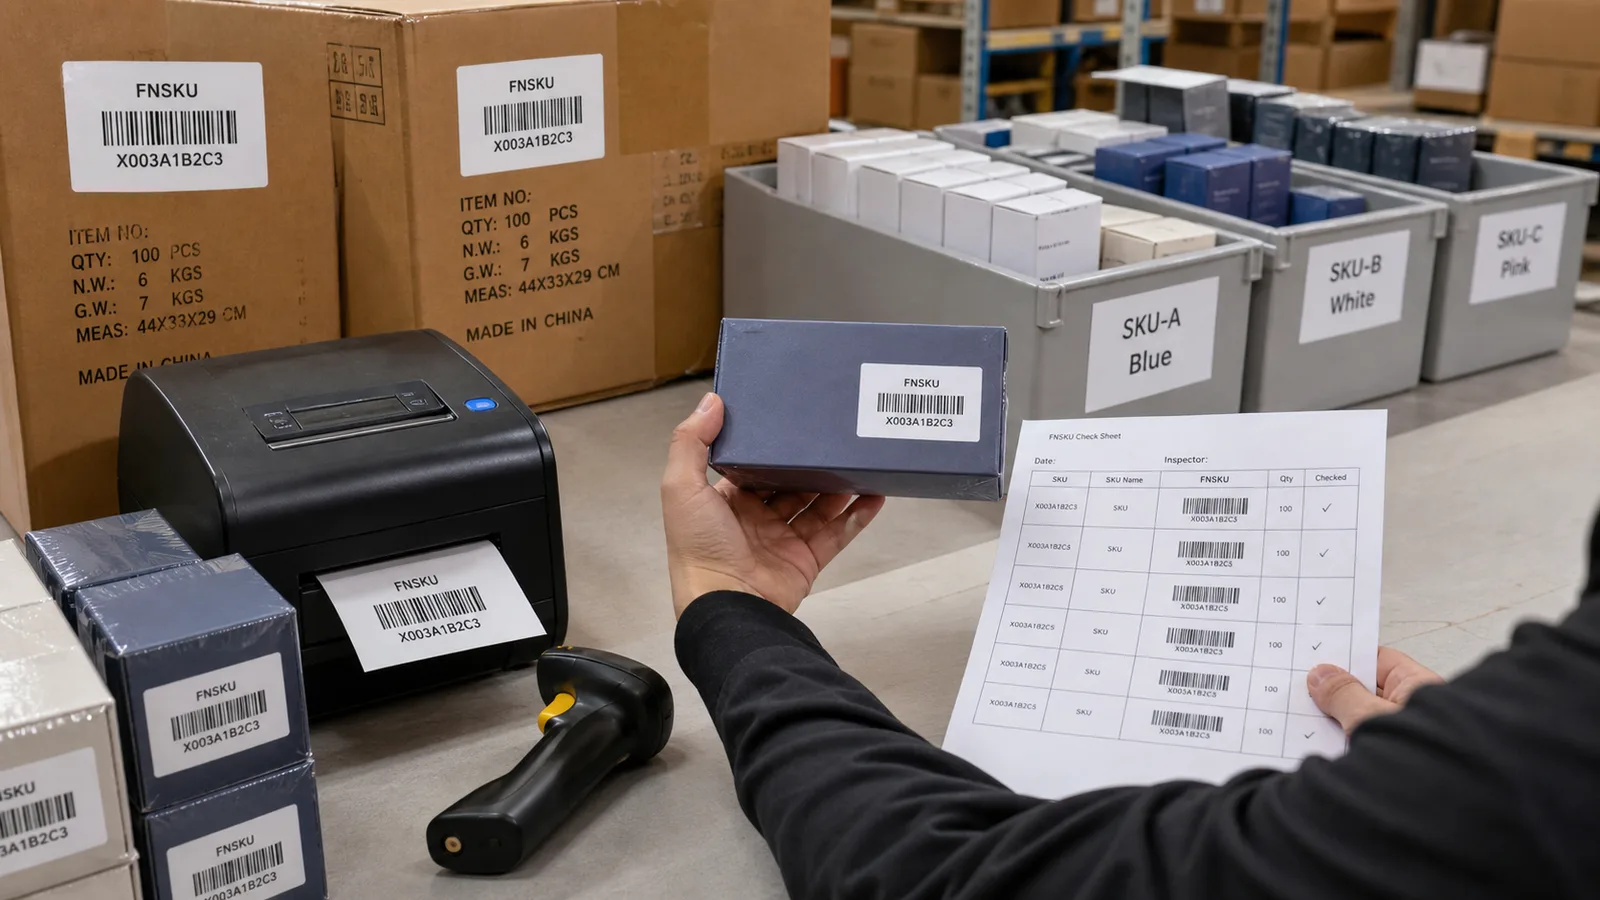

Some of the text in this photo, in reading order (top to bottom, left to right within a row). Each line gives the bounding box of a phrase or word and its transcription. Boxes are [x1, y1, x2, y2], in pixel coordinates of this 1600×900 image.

[136, 83, 198, 98] FNSKU
[509, 76, 555, 93] FNSKU
[494, 131, 573, 152] X003A1B2C3
[117, 152, 223, 168] X003A1B2C3
[460, 189, 532, 212] ITEM NO:
[461, 204, 578, 236] QTY: 100 PCS
[69, 223, 149, 245] ITEM NO:
[463, 227, 579, 258] N.W.: 6 KGS
[1498, 225, 1543, 251] SKU-C
[71, 242, 201, 270] QTY: 100 PCS
[463, 249, 580, 281] G.W.: 7 KGS
[1329, 254, 1382, 283] SKU-B
[1501, 256, 1531, 279] Pink
[73, 265, 202, 294] N.W.: 6 KGS
[465, 263, 620, 304] MEAS: 44X33X29 CM
[75, 288, 204, 318] G.W.: 7 KGS
[1330, 290, 1375, 315] White
[76, 305, 247, 343] MEAS: 44X33X29 CM
[466, 307, 594, 342] MADE IN CHINA
[1122, 307, 1181, 339] SKU-A
[1129, 349, 1172, 375] Blue
[79, 364, 129, 386] MADE
[904, 378, 940, 388] FNSKU
[886, 416, 953, 428] X003A1B2C3
[1100, 432, 1121, 440] Sheet
[1034, 457, 1056, 465] Date:
[1164, 455, 1208, 465] Inspector:
[1123, 476, 1143, 484] Name
[1279, 475, 1293, 484] Qty
[1315, 474, 1347, 482] Checked
[394, 574, 439, 592] FNSKU
[399, 618, 481, 642] X003A1B2C3
[1084, 668, 1100, 676] SKU
[196, 681, 237, 702] FNSKU
[1264, 685, 1278, 693] 100
[1076, 708, 1092, 716] SKU
[183, 720, 260, 753] X003A1B2C3
[216, 834, 255, 857] FNSKU
